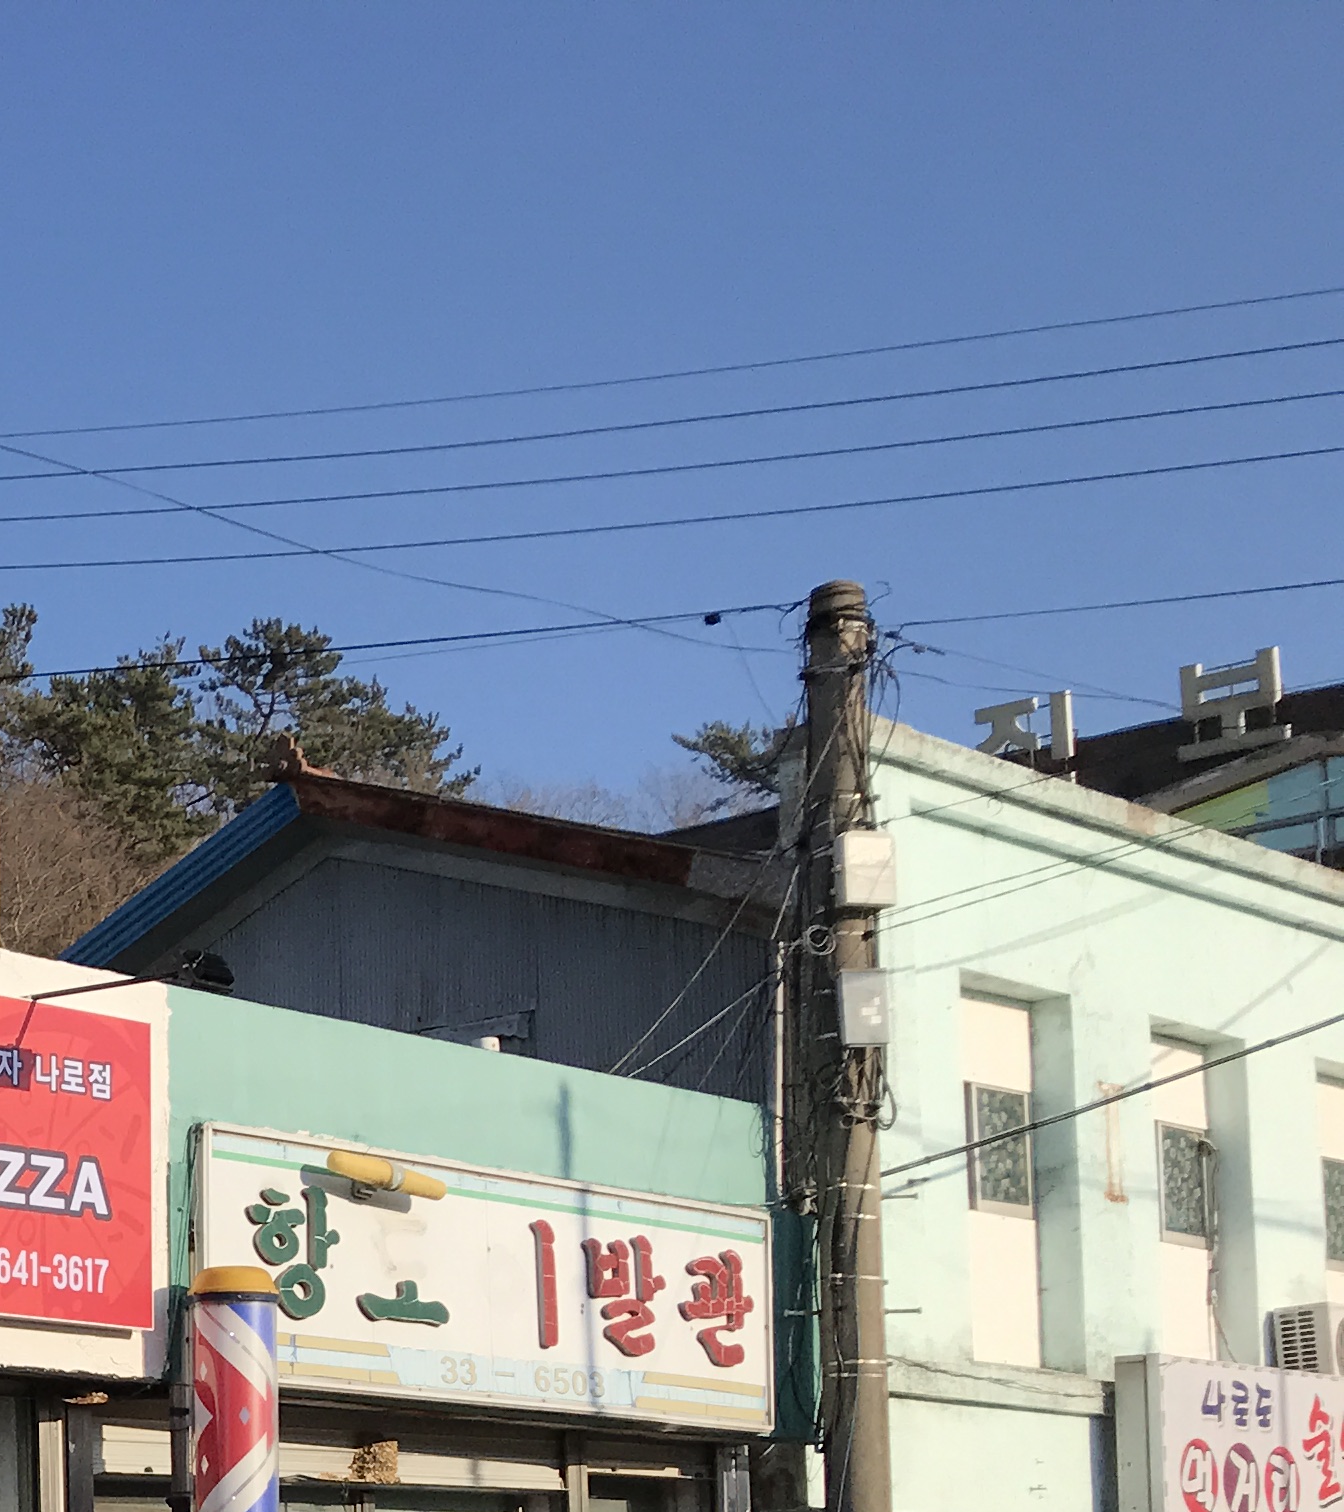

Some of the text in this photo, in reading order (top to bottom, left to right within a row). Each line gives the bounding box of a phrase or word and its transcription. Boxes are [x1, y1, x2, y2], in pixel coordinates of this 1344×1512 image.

[34, 1054, 112, 1100] 나로점
[1201, 1379, 1272, 1428] 나로도
[1302, 1393, 1344, 1508] 술
